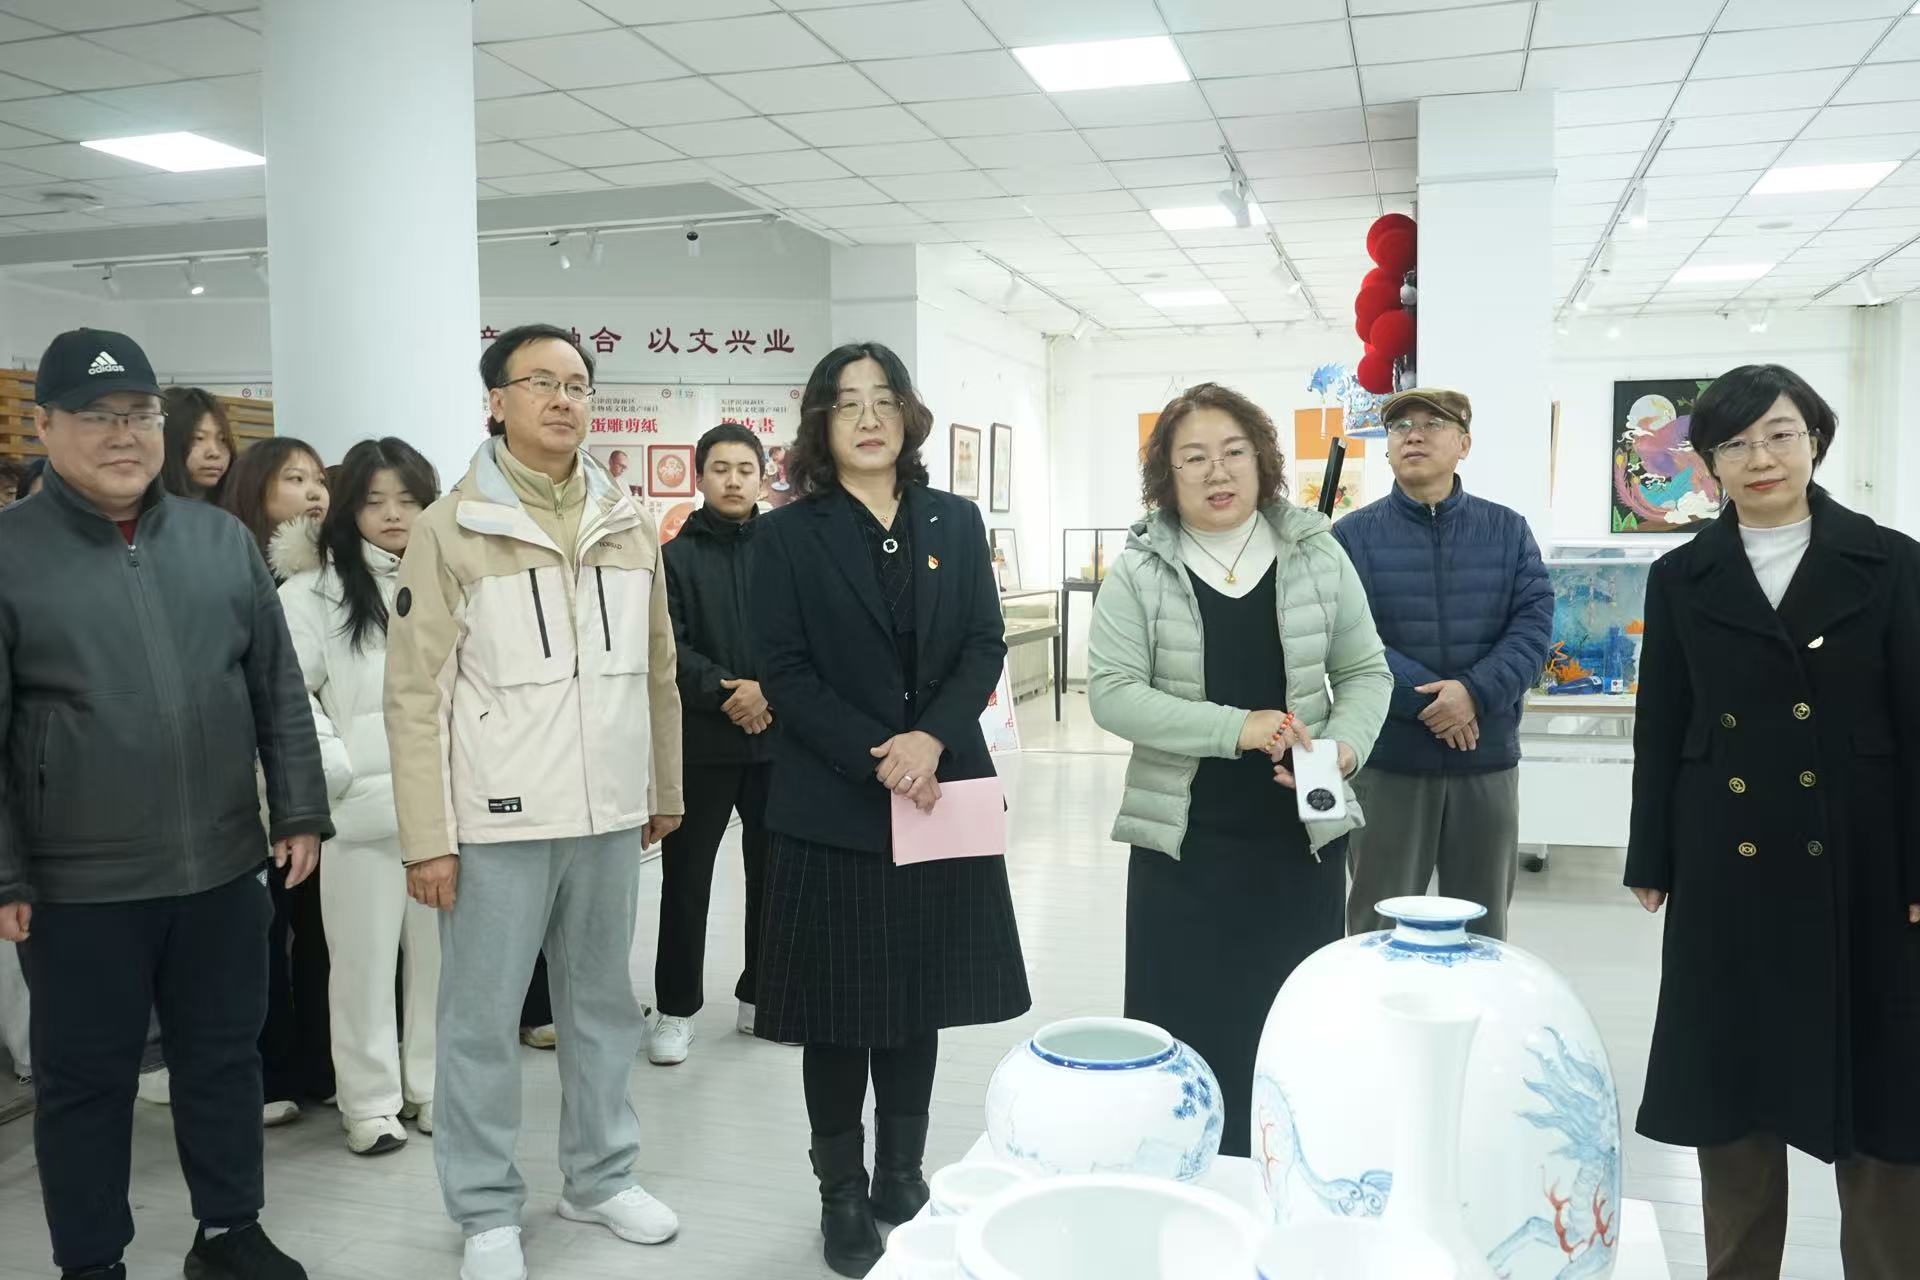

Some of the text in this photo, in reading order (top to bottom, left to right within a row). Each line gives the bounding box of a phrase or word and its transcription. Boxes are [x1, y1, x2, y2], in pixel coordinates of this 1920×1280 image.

[648, 327, 795, 354] 以文兴业
[88, 364, 125, 375] adidas
